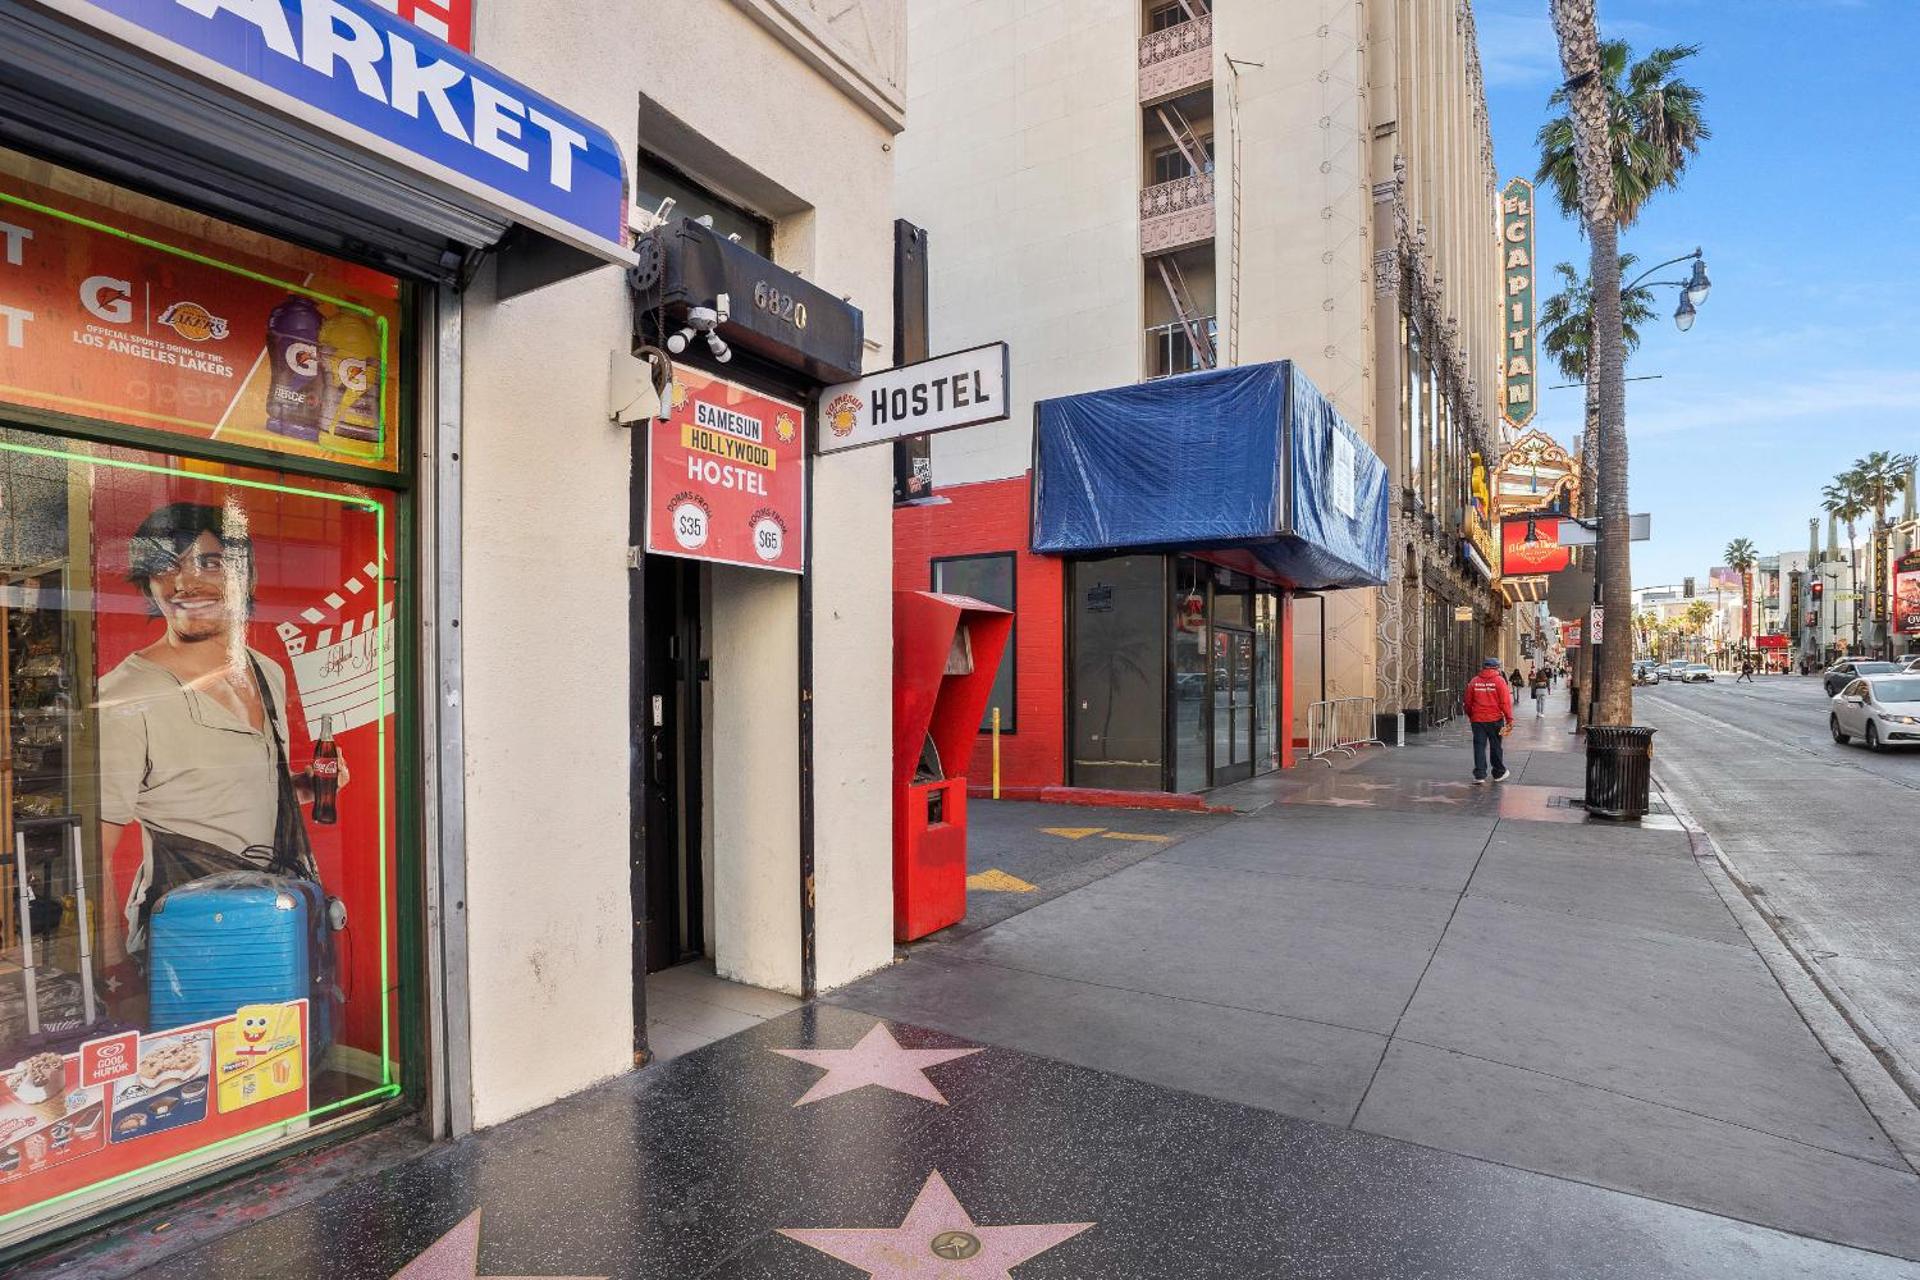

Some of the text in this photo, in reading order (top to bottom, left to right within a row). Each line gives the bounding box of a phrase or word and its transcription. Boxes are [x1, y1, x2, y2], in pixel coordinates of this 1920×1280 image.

[754, 280, 807, 329] 6820
[1505, 218, 1531, 405] CAPITAN
[73, 331, 234, 378] LOS ANGELES LAKERS
[86, 324, 128, 341] OFFICIAL
[129, 334, 165, 350] SPORTS
[871, 369, 990, 426] HOSTEL
[698, 404, 760, 440] SAMESUN
[691, 429, 769, 467] HOLLYWOOD
[687, 455, 768, 496] HOSTEL
[667, 491, 694, 512] DORMS
[679, 514, 701, 536] $35
[759, 530, 778, 550] $65
[93, 1062, 129, 1079] HUMOR
[97, 1055, 124, 1070] GOOD
